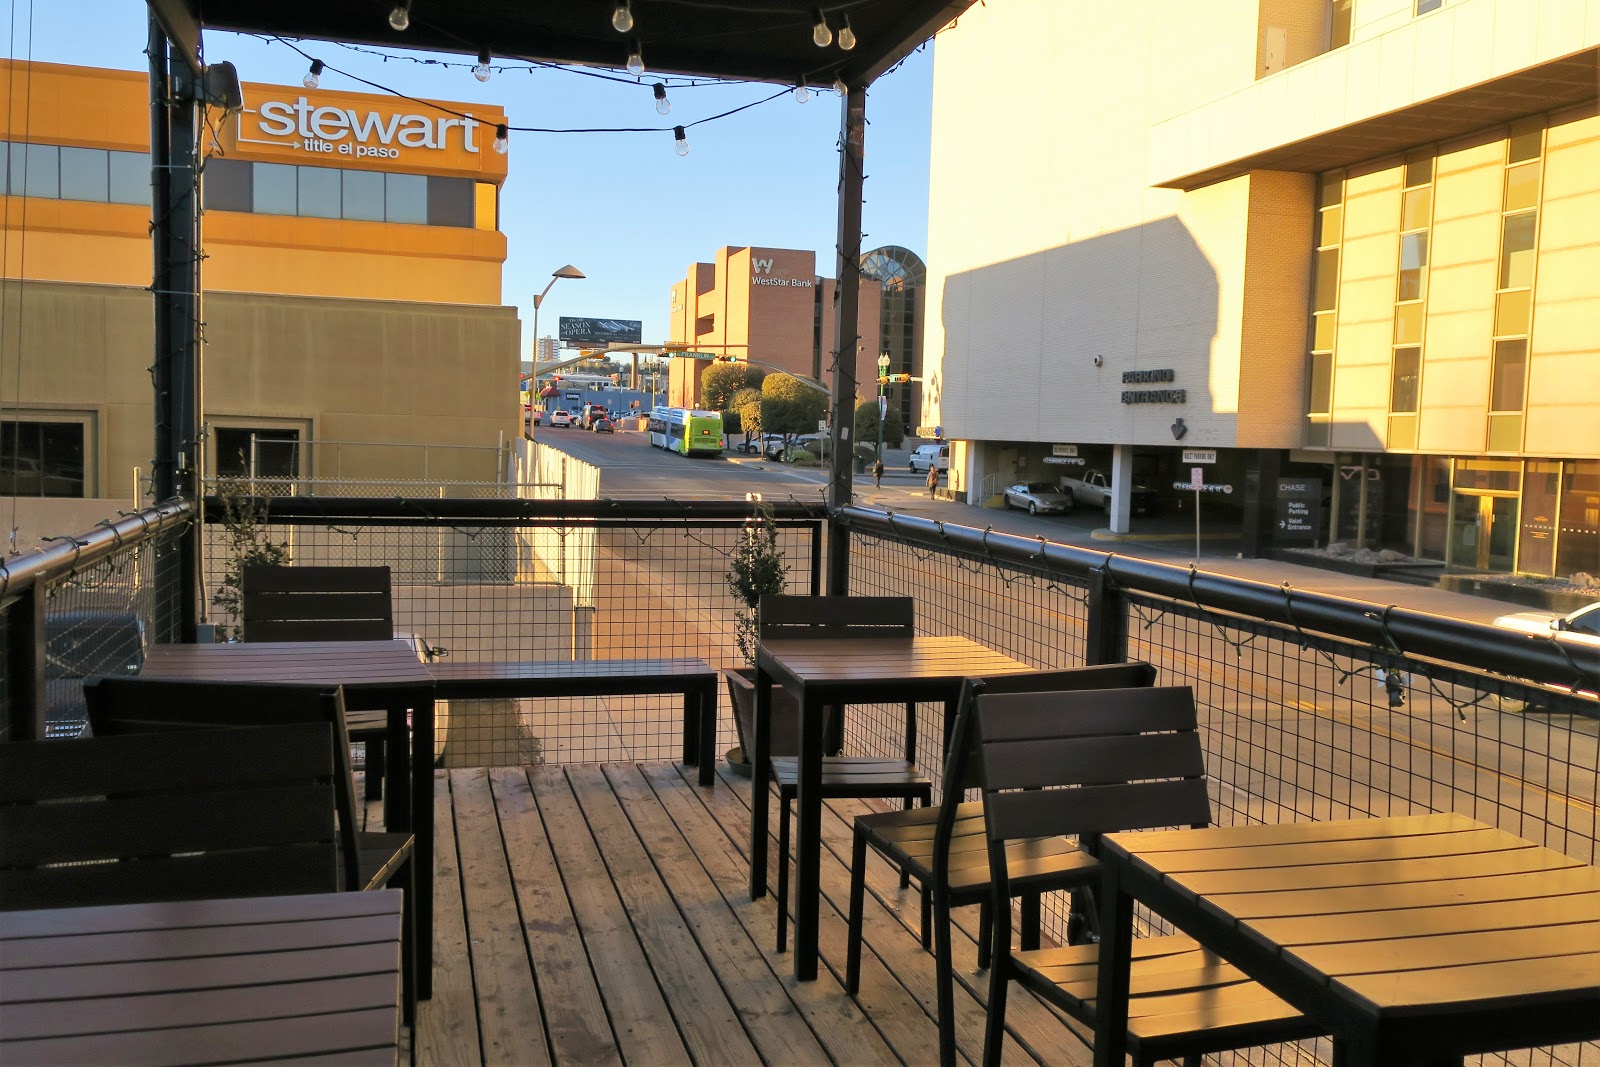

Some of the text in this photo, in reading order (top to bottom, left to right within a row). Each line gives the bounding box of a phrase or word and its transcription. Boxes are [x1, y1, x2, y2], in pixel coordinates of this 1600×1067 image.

[258, 96, 479, 153] stewart
[303, 138, 400, 159] title el paso
[752, 276, 812, 287] WestStar Bank
[560, 321, 591, 330] SEASON
[565, 328, 591, 336] OPERA
[1121, 389, 1186, 403] ENTRANCE
[1194, 452, 1206, 460] PARKING
[1207, 452, 1215, 460] ONLY
